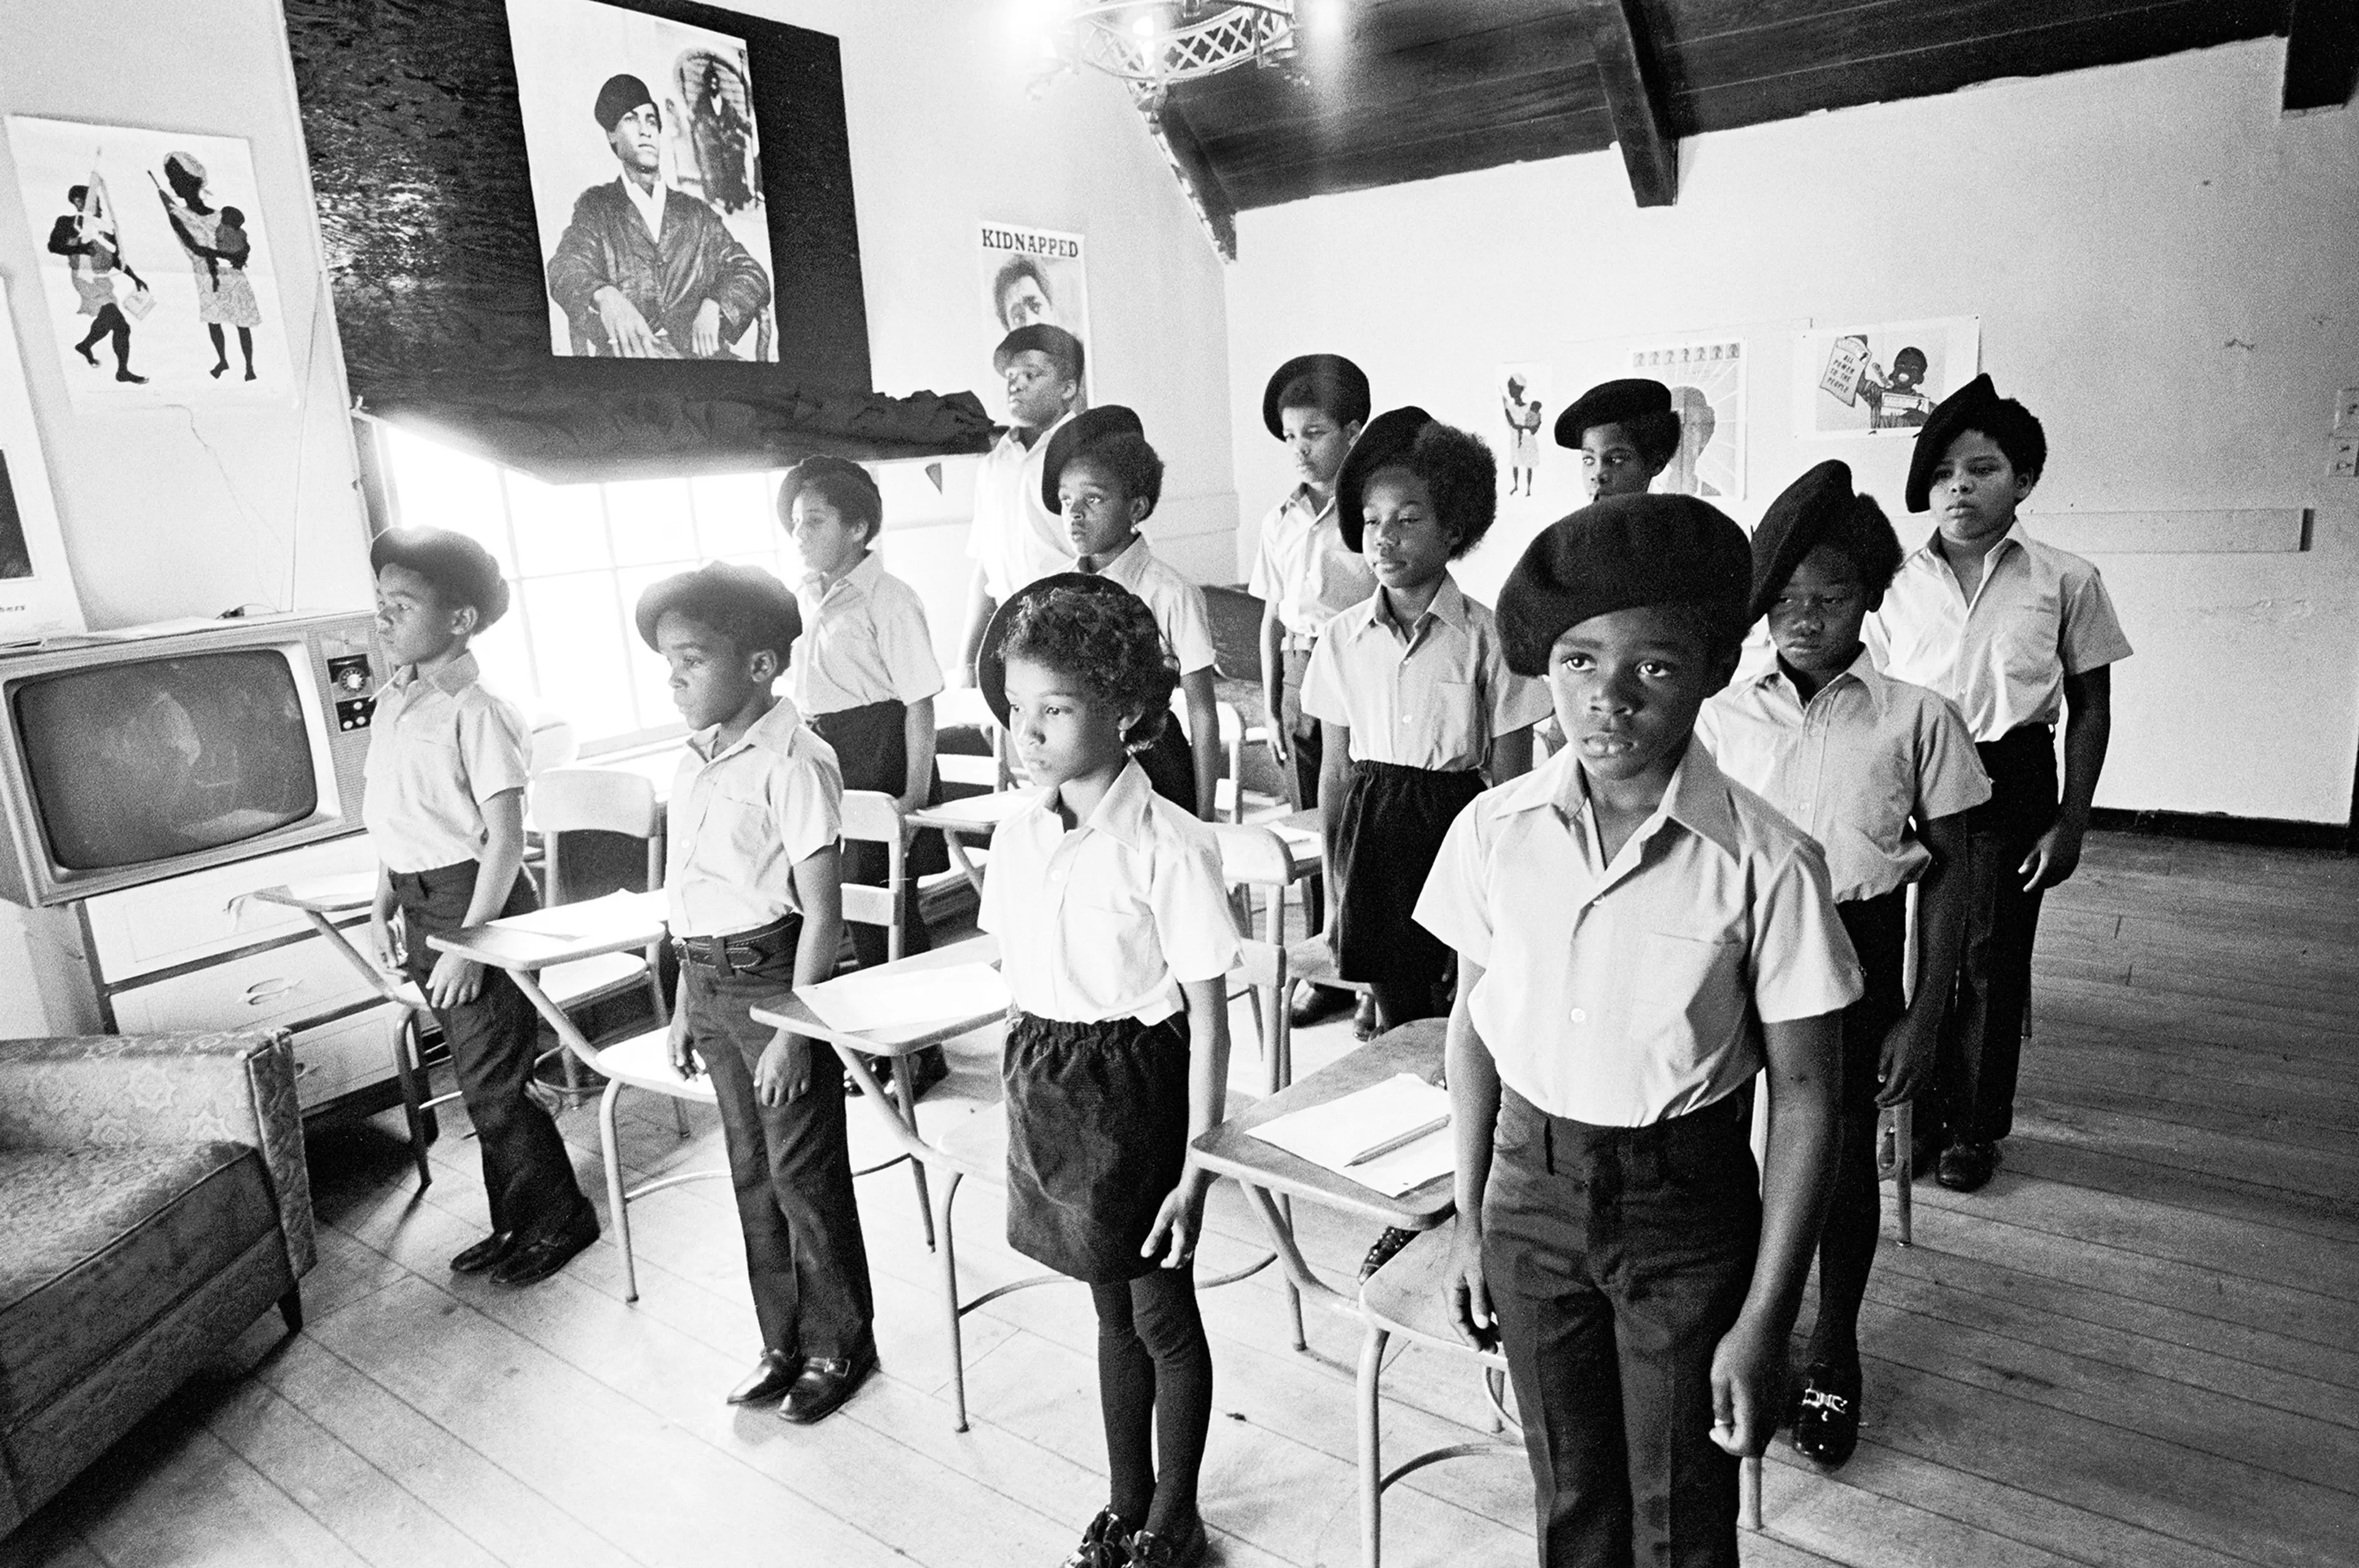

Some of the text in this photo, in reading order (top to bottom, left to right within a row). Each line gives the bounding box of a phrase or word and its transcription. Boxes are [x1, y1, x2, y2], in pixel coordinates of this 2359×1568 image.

[982, 228, 1078, 257] KIDNAPPED
[1833, 359, 1855, 375] POWER
[1843, 354, 1854, 364] ALL
[1830, 368, 1852, 382] TO THE
[1826, 376, 1849, 393] PEOPLE
